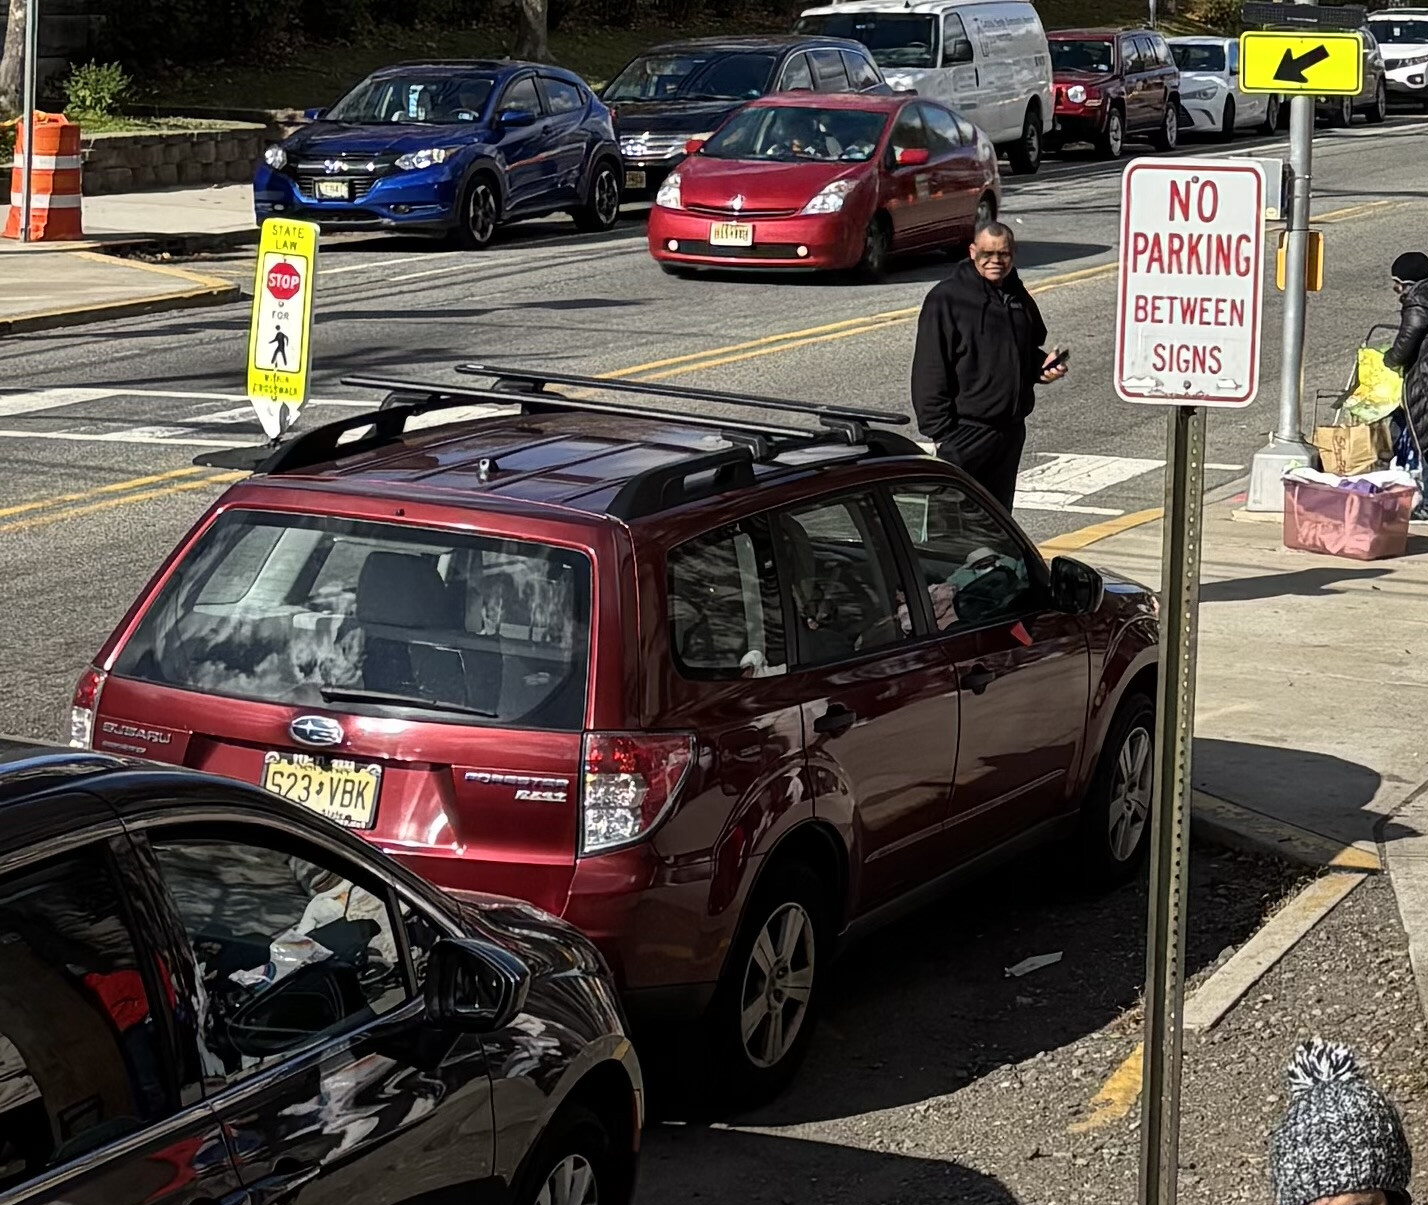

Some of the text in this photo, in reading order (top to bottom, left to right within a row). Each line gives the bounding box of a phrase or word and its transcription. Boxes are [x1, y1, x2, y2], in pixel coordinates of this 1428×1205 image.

[1168, 179, 1219, 224] NO
[272, 224, 305, 239] STATE
[275, 240, 298, 251] LAW
[1132, 231, 1251, 278] PARKING
[268, 272, 300, 290] STOP
[271, 310, 290, 321] FOR
[1134, 294, 1245, 327] BETWEEN
[1152, 343, 1222, 374] SIGNS
[102, 721, 172, 744] SUBARU
[329, 776, 370, 810] VBK
